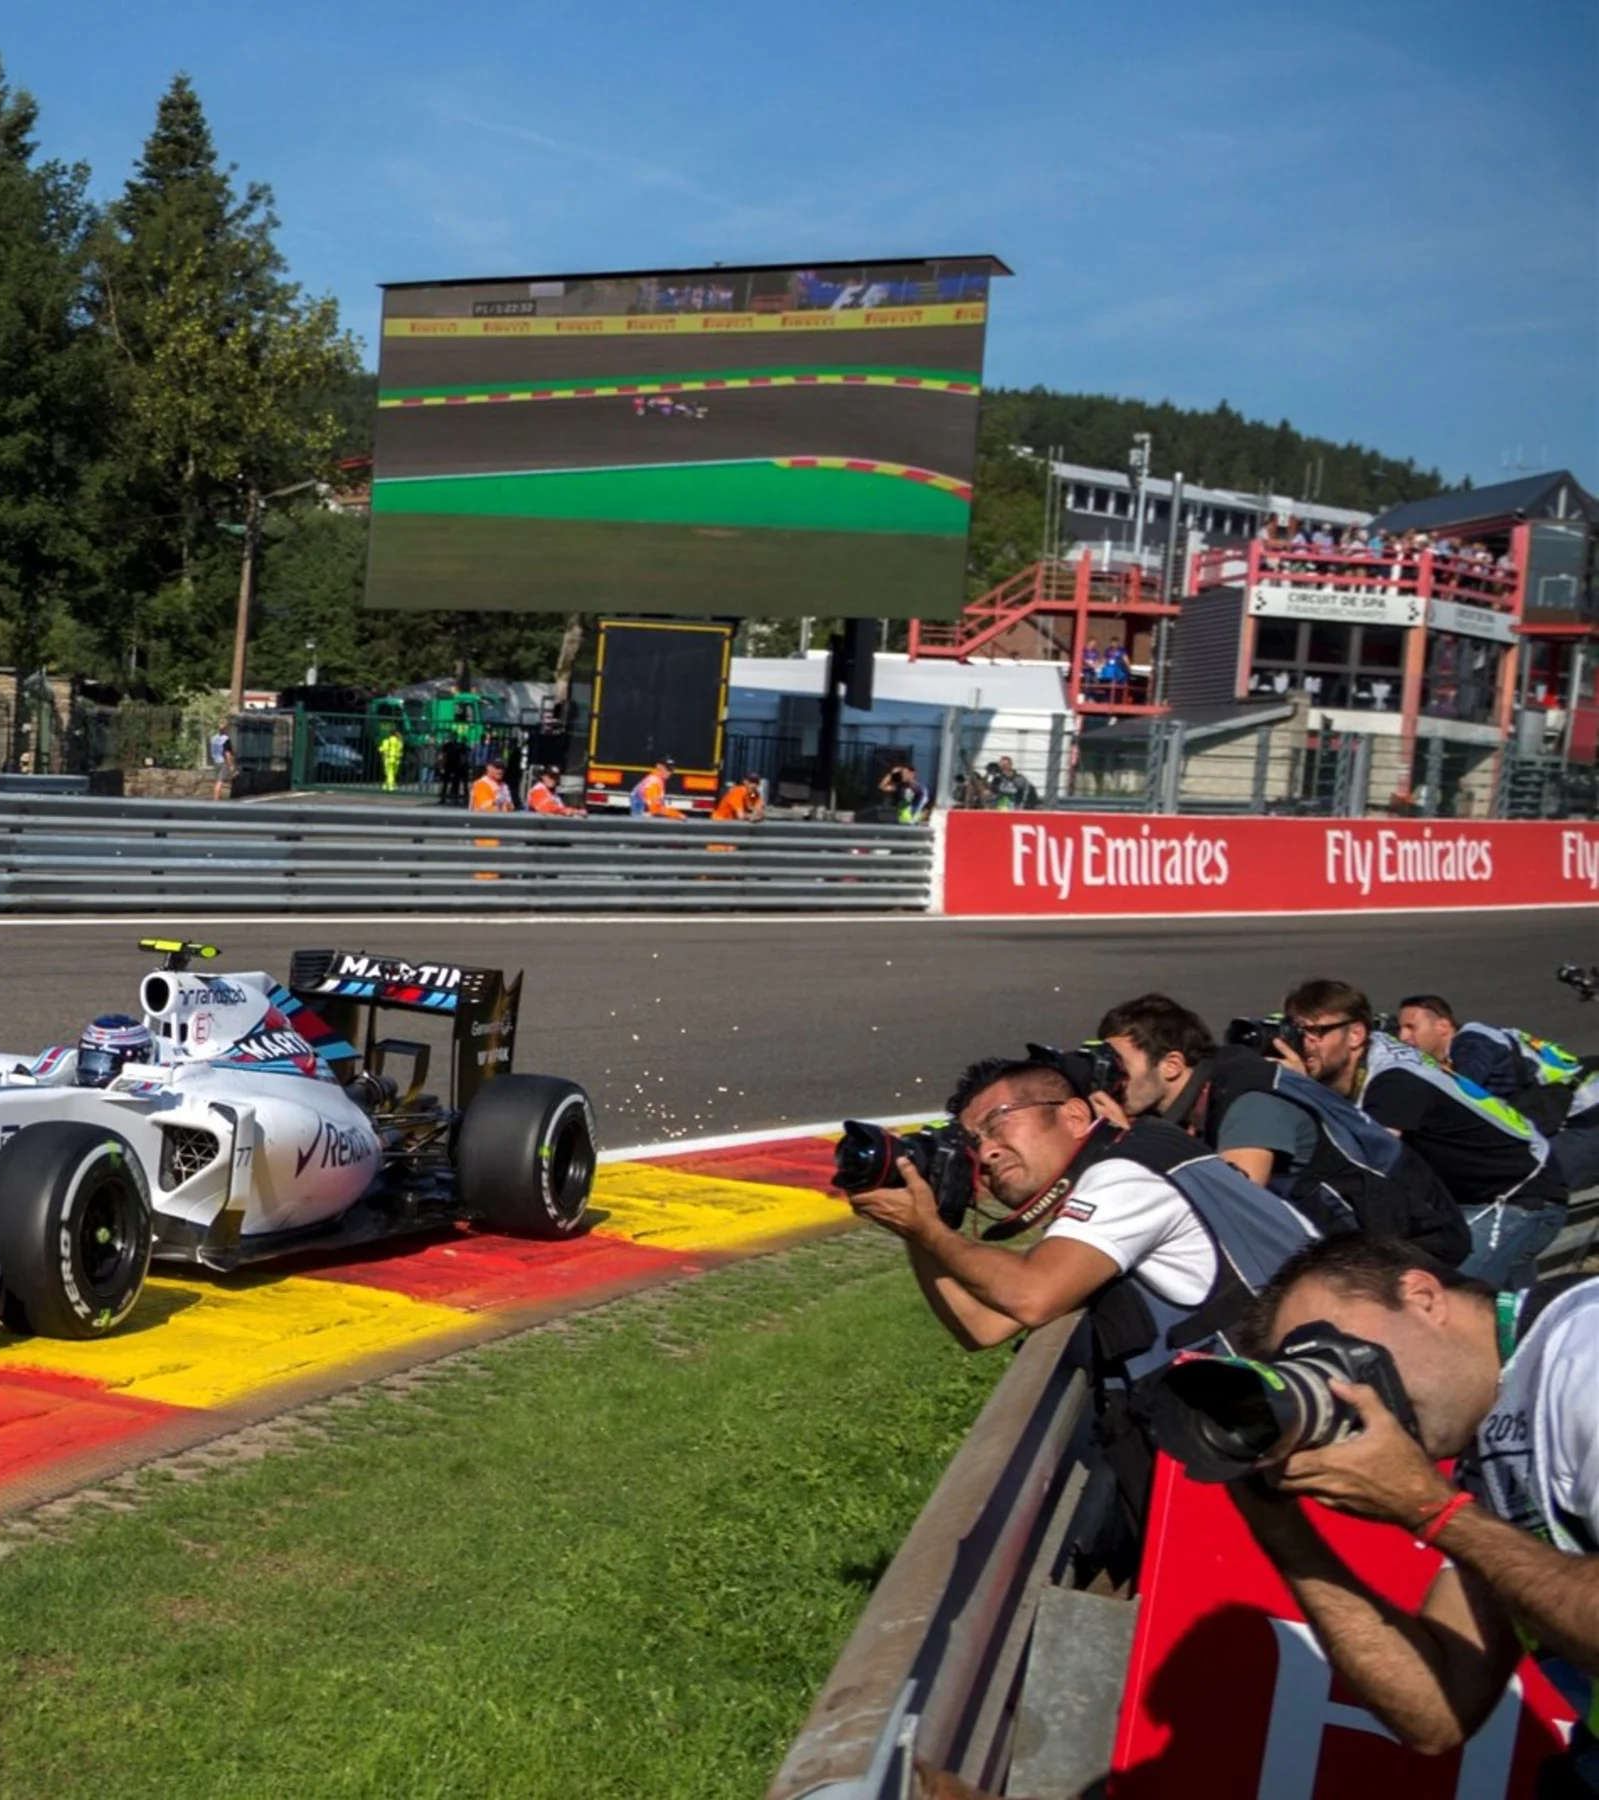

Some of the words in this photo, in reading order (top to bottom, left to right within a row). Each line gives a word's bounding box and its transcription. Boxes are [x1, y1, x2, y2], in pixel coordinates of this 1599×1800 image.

[1287, 592, 1337, 606] CIRCUIT
[1341, 595, 1357, 607] DE
[1361, 597, 1386, 609] SPA
[1011, 823, 1074, 900] Fly
[1081, 823, 1229, 886] Emirates
[1326, 828, 1374, 895] Fly
[1377, 826, 1493, 882] Emirates
[1561, 830, 1599, 890] Fly
[236, 1146, 252, 1168] 77
[1021, 1178, 1071, 1223] Canon
[60, 1225, 92, 1320] ZERO
